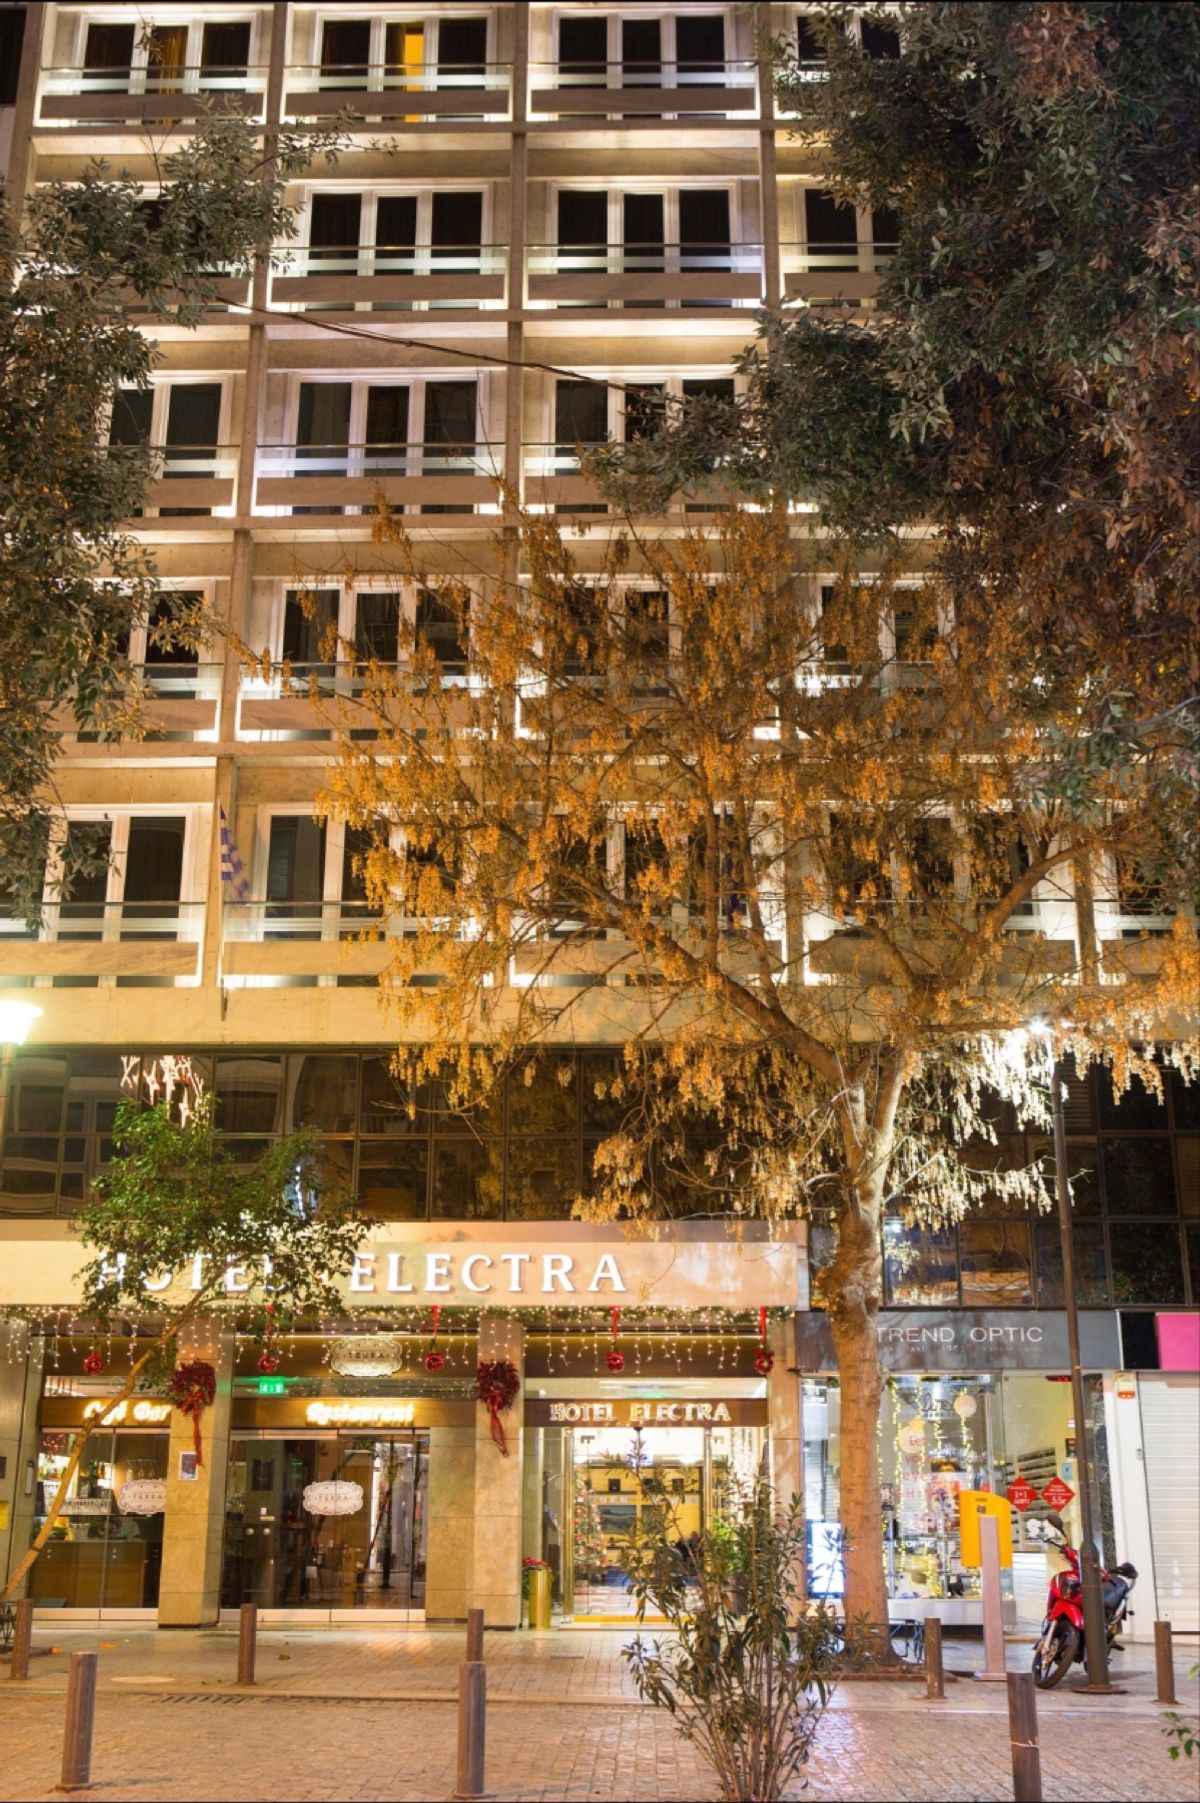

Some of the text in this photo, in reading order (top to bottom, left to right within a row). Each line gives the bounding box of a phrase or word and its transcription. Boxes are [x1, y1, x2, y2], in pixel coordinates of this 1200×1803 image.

[349, 1252, 626, 1292] ELECTRA
[877, 1327, 1043, 1342] TREND OPTIC
[133, 1401, 171, 1421] Bar
[550, 1403, 731, 1422] HOTEL ELECTRA
